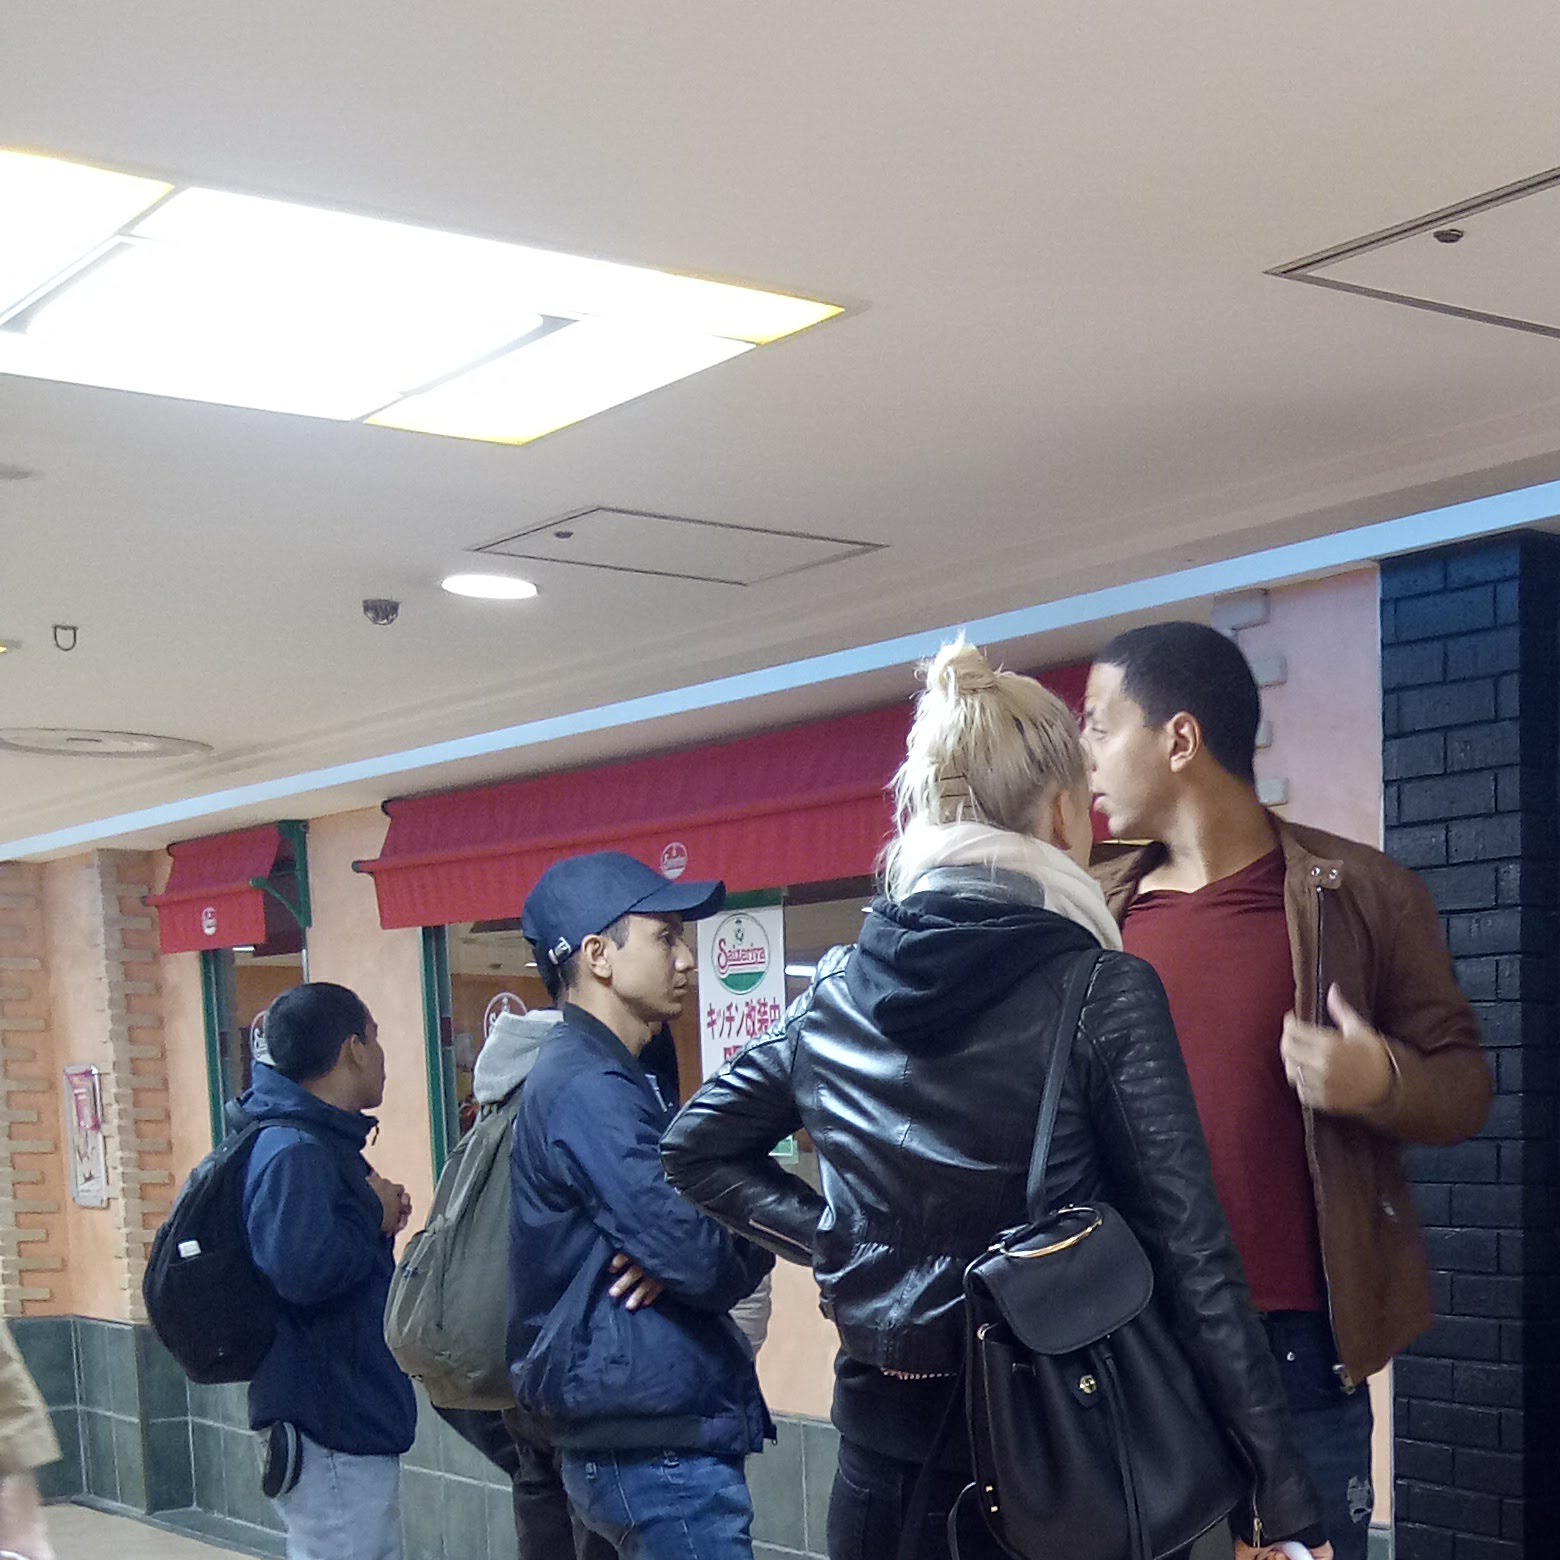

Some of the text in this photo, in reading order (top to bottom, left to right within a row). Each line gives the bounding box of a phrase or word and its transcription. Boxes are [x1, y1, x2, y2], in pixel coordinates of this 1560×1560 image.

[717, 937, 767, 974] Saizeriya
[706, 996, 781, 1040] キッチン改装中
